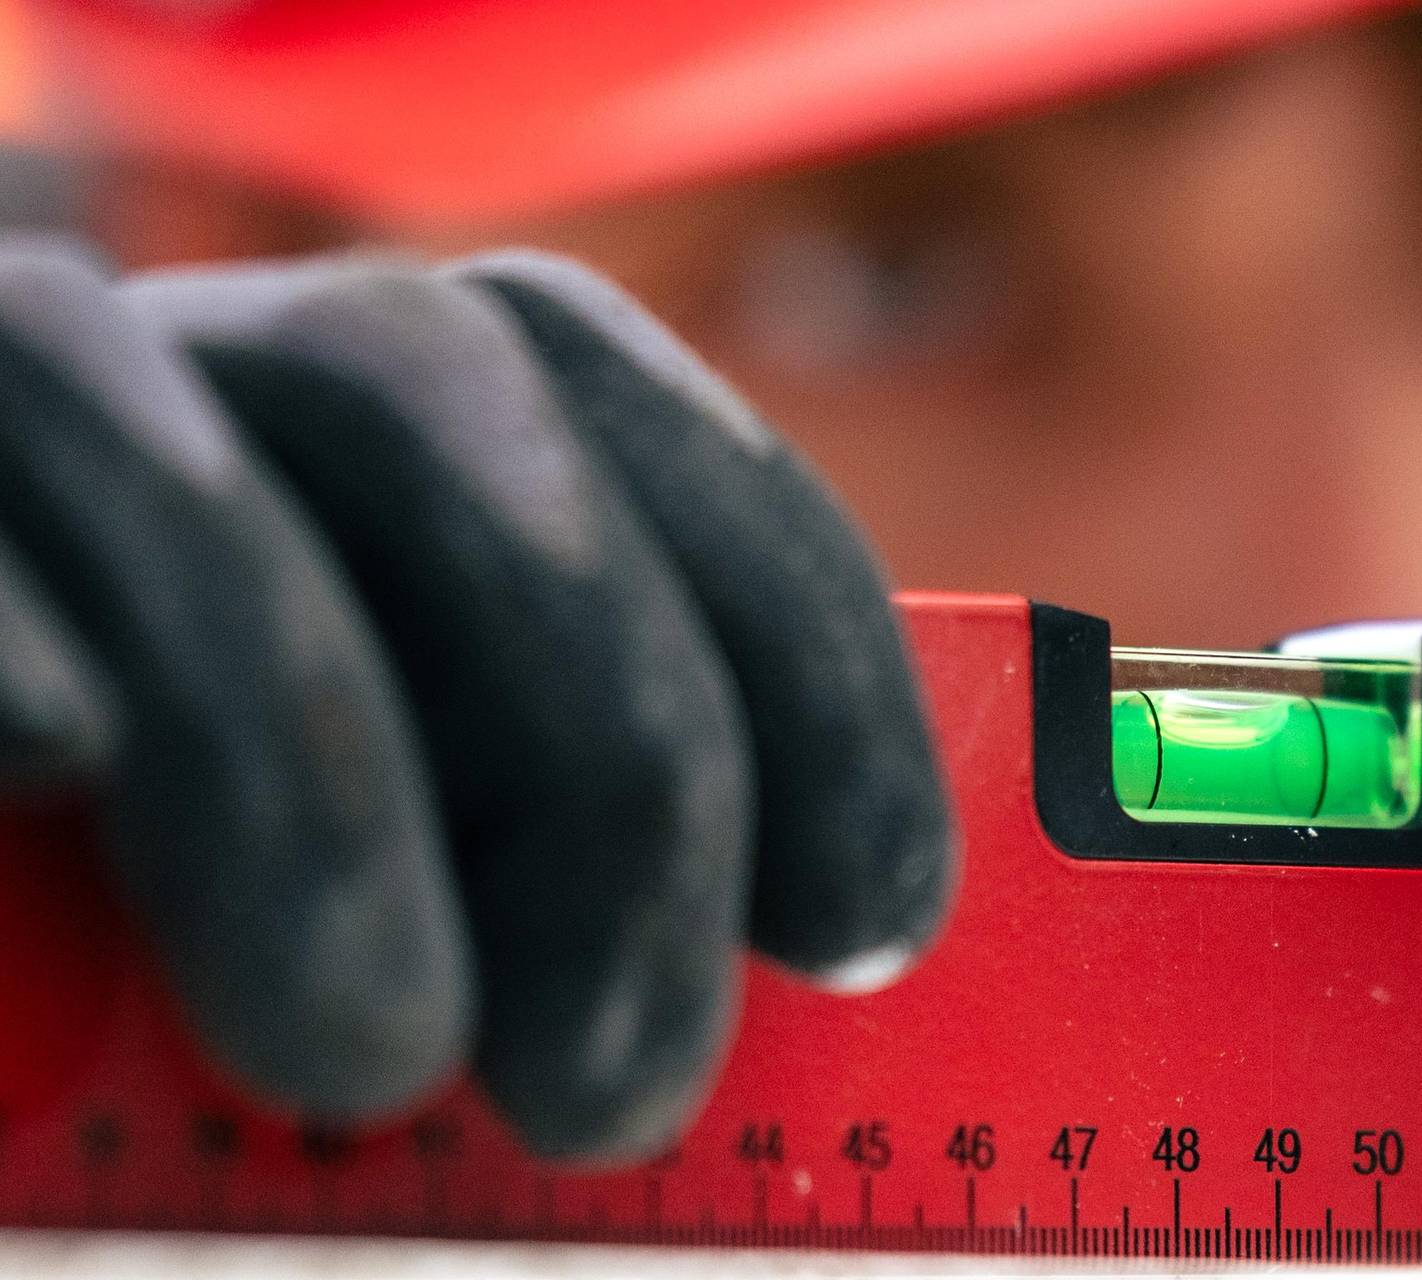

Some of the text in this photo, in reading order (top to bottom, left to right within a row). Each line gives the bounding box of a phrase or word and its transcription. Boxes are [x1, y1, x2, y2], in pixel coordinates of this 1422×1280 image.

[736, 1121, 783, 1167] 44
[842, 1122, 891, 1170] 45
[946, 1124, 995, 1171] 46
[1050, 1126, 1097, 1170] 47
[1152, 1127, 1200, 1172] 48
[1254, 1128, 1301, 1173] 49
[1353, 1129, 1404, 1175] 50
